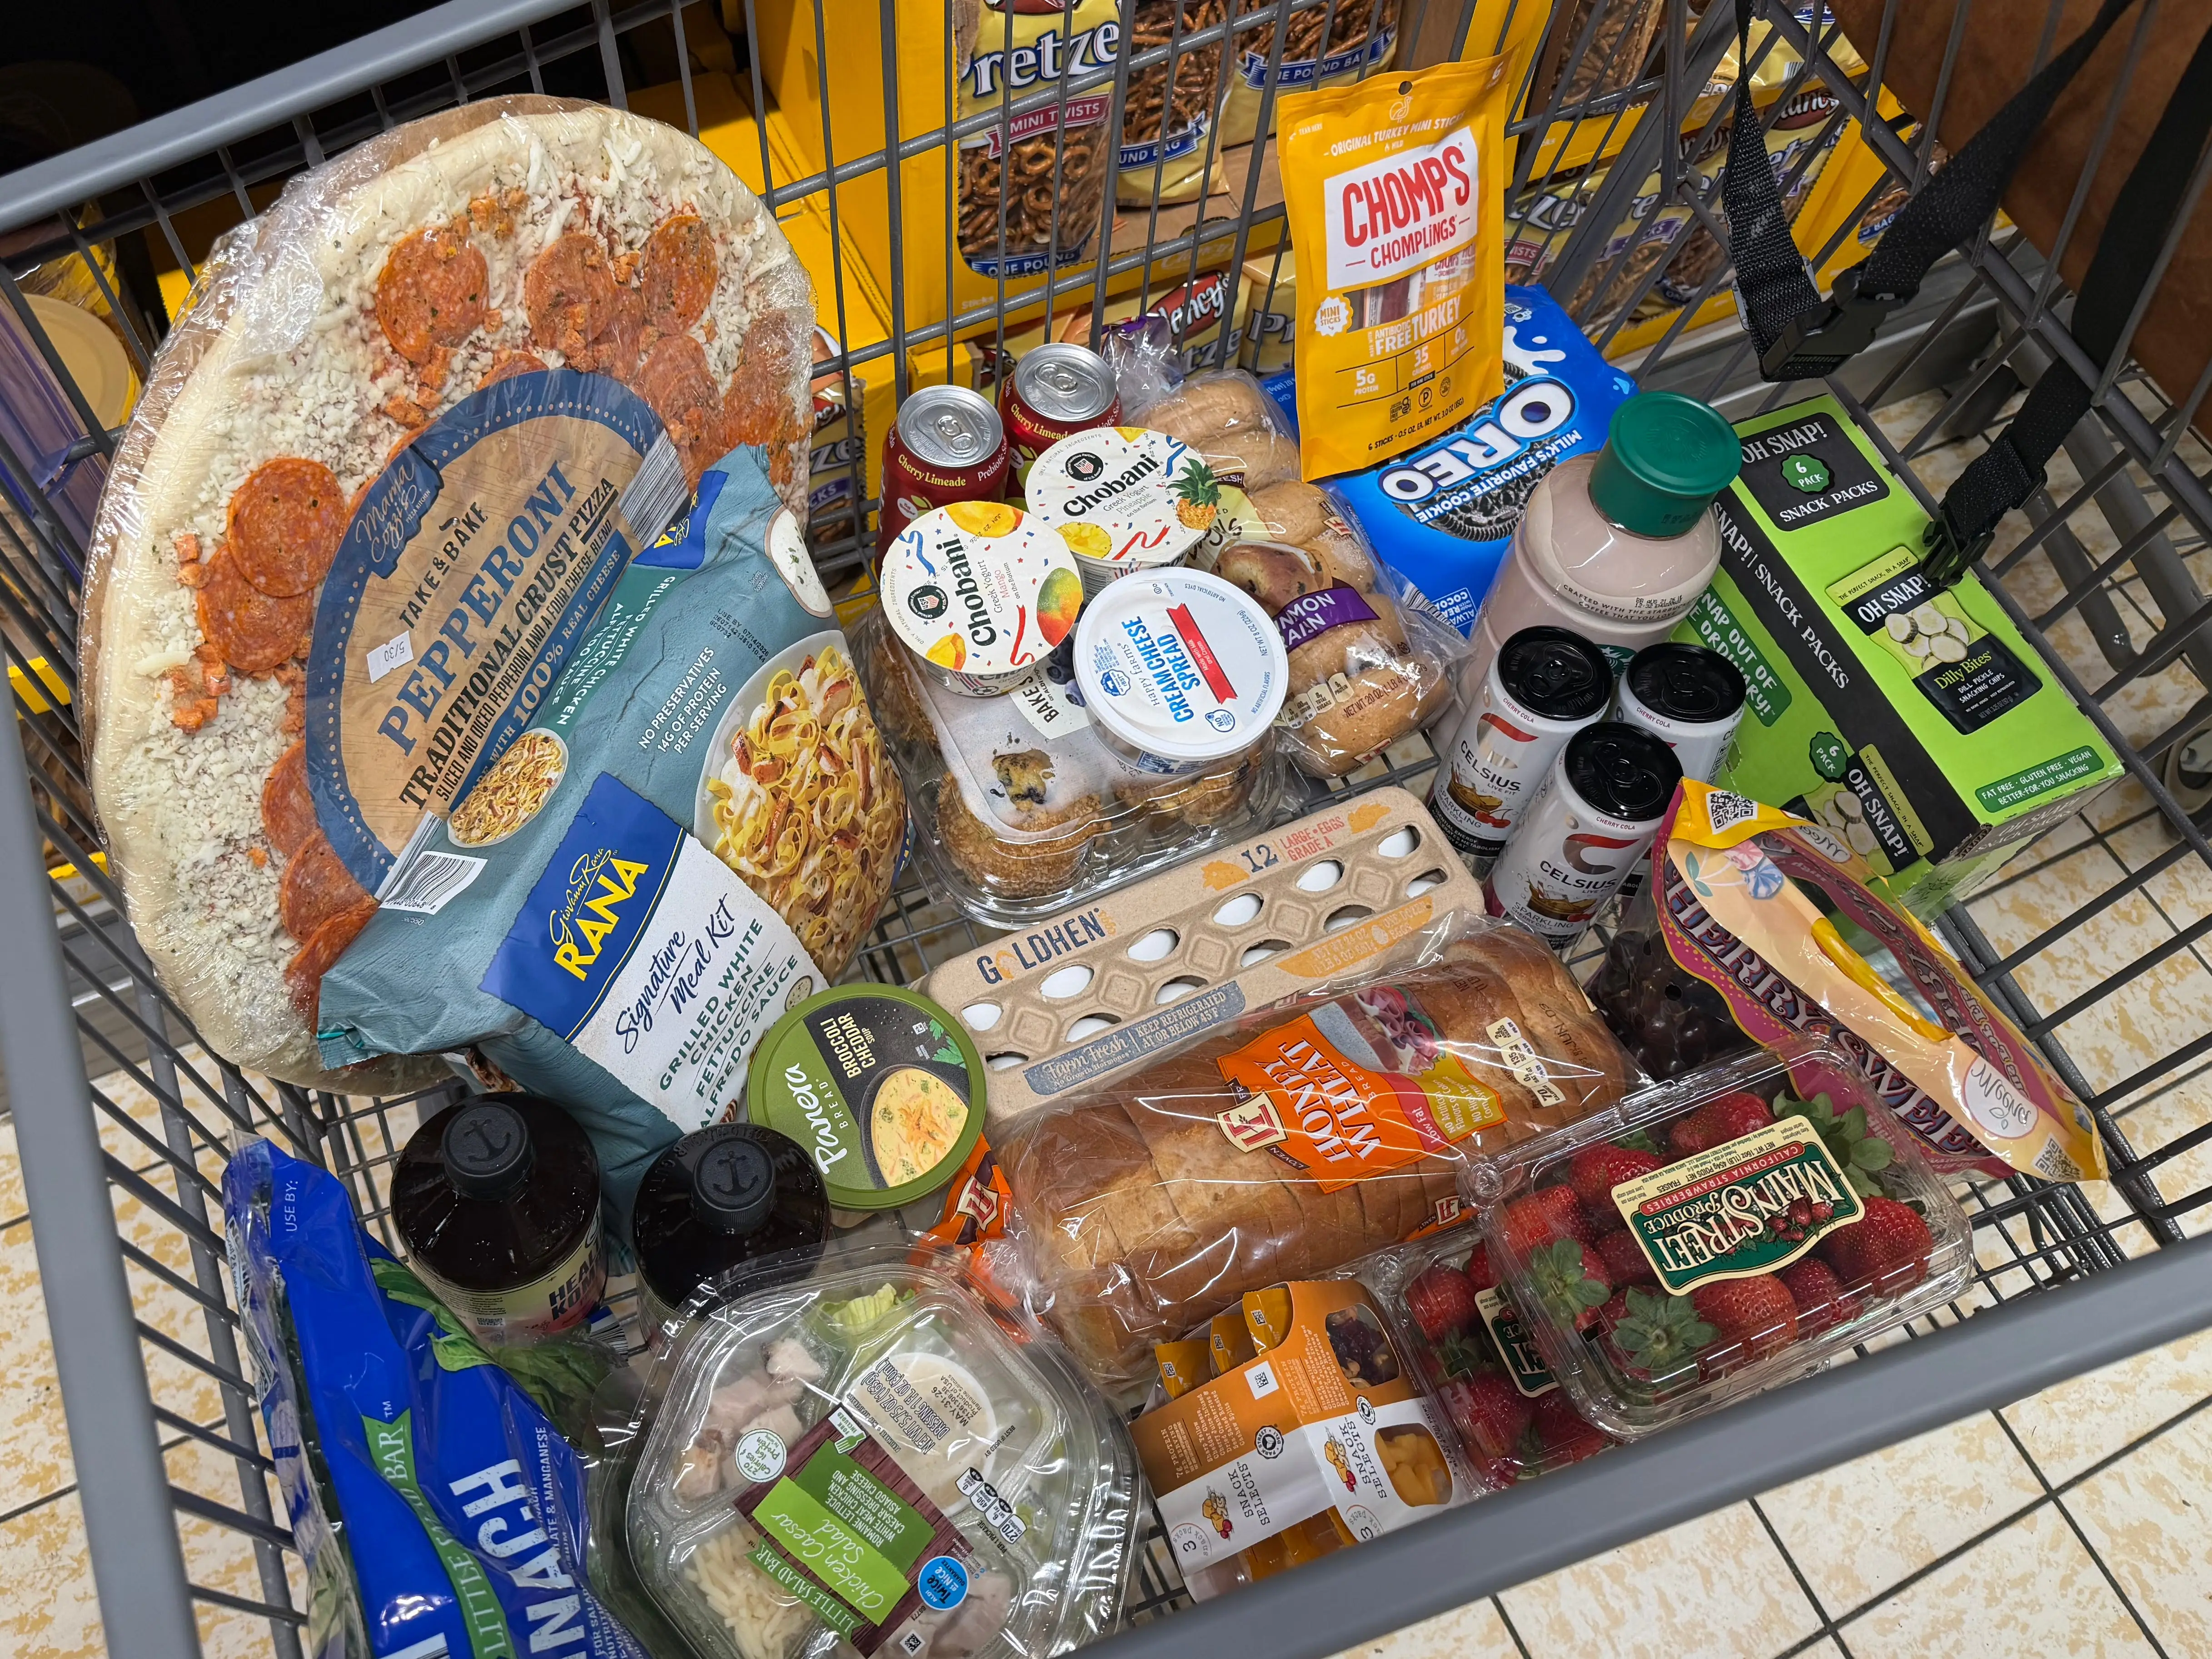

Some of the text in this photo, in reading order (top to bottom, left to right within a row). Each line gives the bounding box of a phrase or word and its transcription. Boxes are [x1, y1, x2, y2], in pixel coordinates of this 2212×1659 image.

[1010, 114, 1043, 134] MINI
[1330, 135, 1372, 157] ORIGINAL
[1374, 125, 1409, 143] TURKEY
[1410, 119, 1432, 135] MINI
[1391, 140, 1404, 149] MILD
[1342, 145, 1470, 247] CHOMPS
[1320, 306, 1340, 317] MINI
[1320, 317, 1341, 326] STICKS
[1375, 332, 1412, 356] FREE
[1412, 294, 1461, 342] TURKEY
[1375, 320, 1411, 340] ANTIBIOTIC
[1414, 346, 1429, 368] 35
[1354, 384, 1379, 396] PROTEIN
[1382, 376, 1576, 500] OREO
[1741, 422, 1828, 463] OH SNAP!
[898, 449, 1005, 488] Cherry Limeade Prebiotic
[1063, 453, 1161, 517] Chobani
[1415, 430, 1582, 524] MILK'S FAVORITE COOKIE
[1798, 473, 1823, 487] PACK
[356, 462, 415, 539] Mama
[1103, 484, 1150, 512] Greek Yogurt
[1116, 492, 1151, 514] Pineapple
[1779, 481, 1878, 522] SNACK PACKS
[399, 572, 441, 629] TAKE
[443, 503, 489, 561] BAKE
[993, 570, 1011, 599] Mango
[378, 461, 577, 757] PEPPERONI
[936, 538, 997, 647] Chobani
[1564, 584, 1599, 605] CRAFTED
[1602, 603, 1625, 613] WITH
[1579, 601, 1609, 615] COFFEE
[1714, 501, 1849, 689] SNAP! SNACK PACKS
[1858, 573, 1932, 623] OH SNAP!
[399, 478, 615, 810] TRADITIONAL CRUST PIZZA
[894, 609, 911, 632] NATURAL
[910, 632, 925, 645] ONLY
[1701, 592, 1777, 690] NAP OUT OF
[384, 640, 406, 663] 5/30
[490, 549, 621, 765] WITH 100% REAL CHEESE
[557, 575, 676, 726] GRILLED WHITE CHICKEN
[571, 614, 633, 685] FETTUCCINE
[1121, 616, 1194, 723] CREAM CHEESE
[1157, 634, 1201, 691] SPREAD
[1933, 653, 1991, 690] Dilly Bites
[638, 646, 715, 749] NO PRESERVATIVES
[1022, 686, 1060, 723] BAKE
[1958, 669, 1994, 694] DILL PICKLE
[1959, 685, 1988, 703] SNACKING
[1988, 673, 2005, 688] CHIPS
[1503, 697, 1534, 723] CHERRY COLA
[1461, 740, 1521, 792] CELSIUS
[1816, 747, 1836, 772] PACK
[1982, 750, 2092, 800] FAT FREE GLUTEN FREE VEGAN
[1439, 784, 1482, 828] SPARKLING
[1998, 763, 2090, 806] BETTER-FOR-YOU SNACKING
[1280, 816, 1345, 850] LARGE EGGS
[1848, 768, 1909, 857] OH SNAP!
[1241, 844, 1279, 873] 12
[1287, 836, 1334, 862] GRADE A
[1539, 860, 1617, 890] CELSIUS
[554, 858, 648, 981] RANA
[1516, 902, 1574, 928] SPARKLING
[670, 893, 735, 1015] Meal Kit
[1665, 866, 1831, 1028] HERRY
[616, 930, 685, 1054] Signature
[660, 918, 762, 1091] GRILLED WHITE
[691, 964, 753, 1065] CHICKEN
[1136, 991, 1226, 1038] KEEP REFRIGERATED
[696, 961, 774, 1098] FETTUCCINE
[700, 954, 798, 1128] ALFREDO SAUCE
[821, 1017, 862, 1079] BROCCOLI
[838, 1012, 876, 1069] CHEDDAR
[1043, 1034, 1130, 1079] Farm Fresh
[1340, 1059, 1378, 1100] BREAD
[784, 1062, 847, 1175] Panera
[819, 1081, 849, 1129] BREAD
[1255, 1059, 1356, 1164] HONEY
[1277, 1037, 1383, 1162] WHEAT
[1731, 1146, 1798, 1177] CALIFORNIA
[1646, 1171, 1728, 1213] STRAWBERRIES
[1657, 1179, 1681, 1193] FRAISES
[285, 1204, 298, 1232] USE
[1644, 1191, 1722, 1235] PRODUCE
[1652, 1160, 1845, 1273] MAIN STREET
[536, 1426, 555, 1501] MANGANESE
[1338, 1424, 1371, 1485] SNACK
[1346, 1421, 1387, 1499] SELECTS
[1228, 1468, 1254, 1518] SNACK
[1238, 1463, 1270, 1525] SELECTS
[380, 1424, 506, 1654] LITTLE BAR
[771, 1512, 824, 1558] Caesar
[813, 1519, 864, 1563] Salad
[854, 1518, 886, 1549] ROMAINE
[755, 1544, 855, 1634] LITTLE SALAD BAR
[825, 1553, 884, 1609] Chicken
